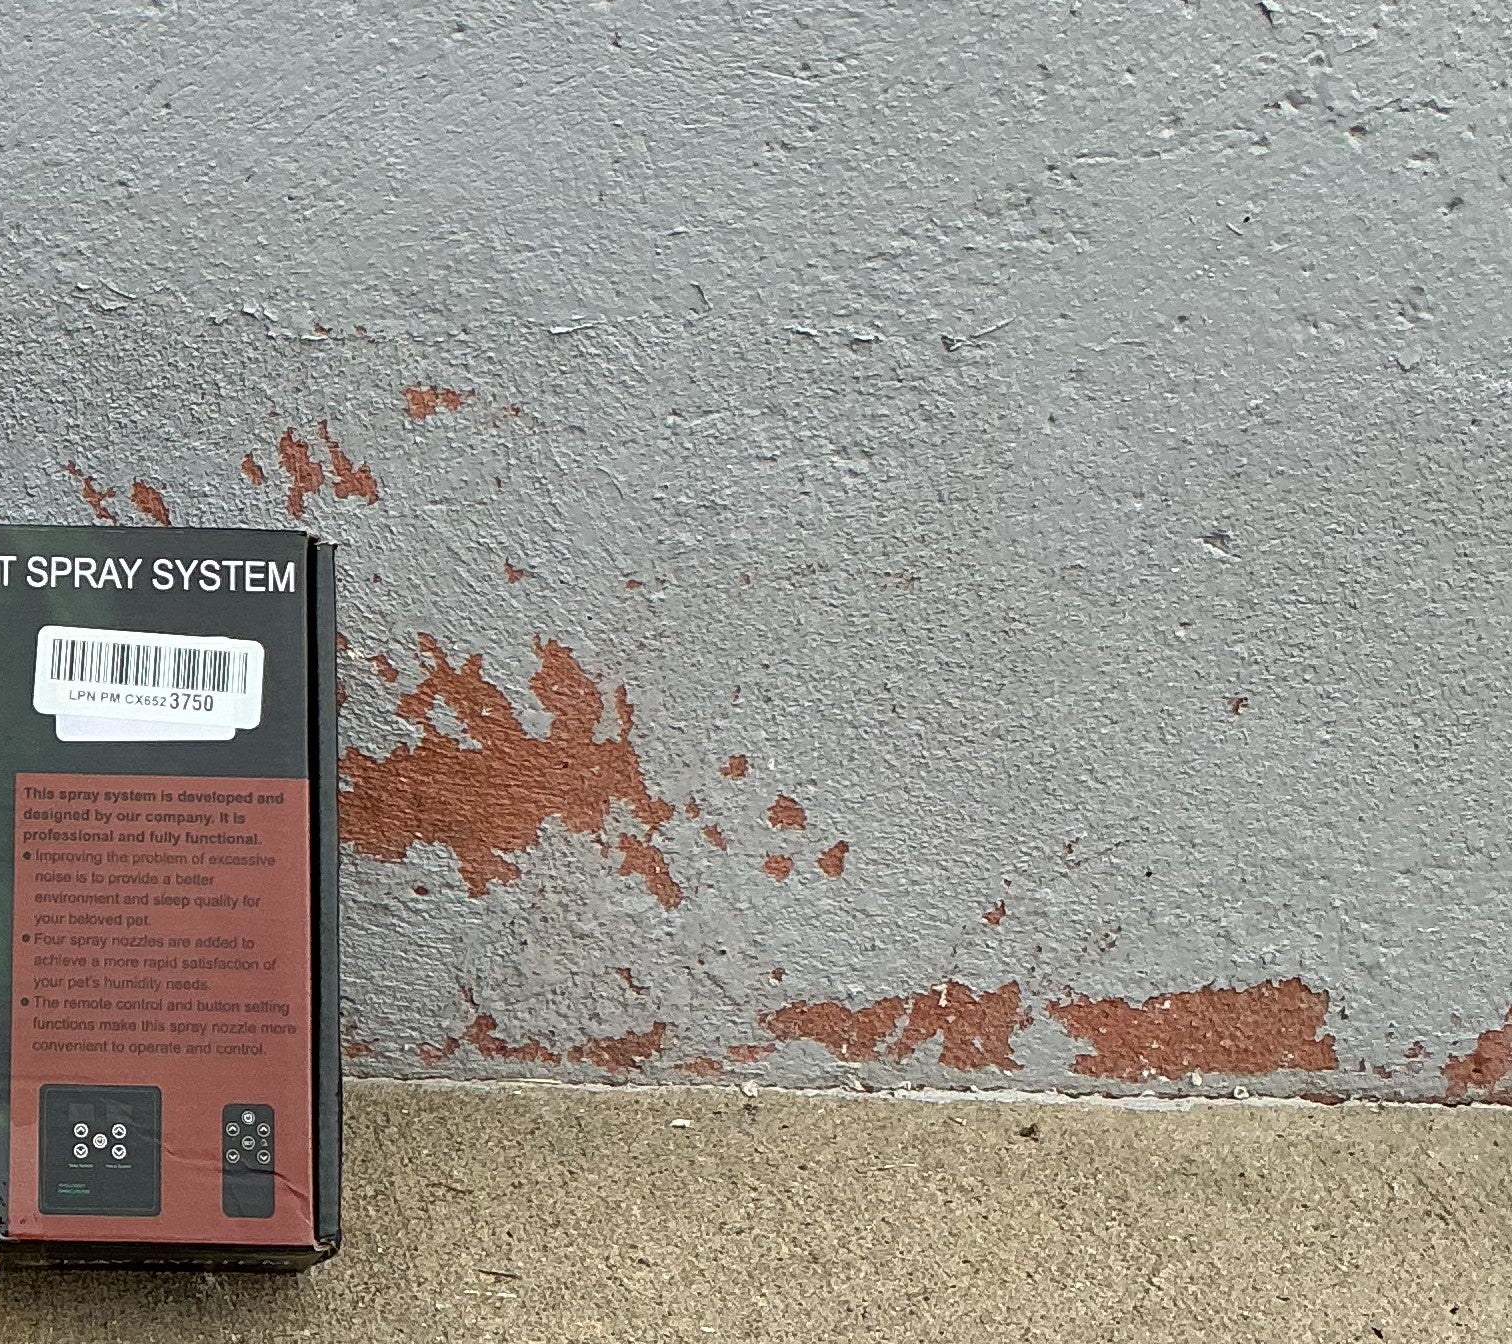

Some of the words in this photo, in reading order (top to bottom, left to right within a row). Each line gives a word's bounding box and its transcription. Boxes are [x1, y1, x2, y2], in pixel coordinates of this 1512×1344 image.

[26, 556, 142, 589] SPRAY
[152, 559, 296, 593] SYSTEM
[69, 690, 95, 702] LPN
[100, 692, 120, 703] PM
[24, 787, 55, 800] This
[59, 789, 99, 803] spray
[104, 790, 156, 804] system
[161, 790, 173, 803] is
[178, 791, 253, 806] developed
[257, 793, 284, 805] and
[23, 808, 90, 824] designed
[94, 809, 112, 824] by
[116, 814, 141, 822] our
[233, 812, 245, 824] is
[23, 829, 113, 844] professional
[118, 830, 145, 843] and
[150, 831, 180, 846] fully
[185, 832, 262, 845] functional.
[35, 849, 102, 865] Improving
[107, 851, 128, 863] the
[132, 851, 187, 866] problem
[192, 853, 205, 865] of
[209, 853, 276, 866] excessive
[35, 871, 71, 883] noise
[76, 872, 87, 884] is
[92, 872, 104, 884] to
[108, 873, 159, 885] provide
[163, 876, 171, 885] a
[175, 873, 214, 886] better
[34, 891, 119, 904] environment
[123, 892, 149, 905] and
[153, 892, 190, 909] sleep
[194, 893, 238, 910] quality
[242, 896, 261, 907] for
[34, 914, 64, 926] your
[68, 913, 122, 926] beloved
[34, 933, 66, 945] Four
[70, 935, 107, 949] spray
[111, 935, 164, 947] nozzles
[168, 938, 190, 948] are
[195, 936, 237, 949] added
[242, 937, 255, 949] to
[33, 954, 87, 967] achieve
[91, 957, 100, 967] a
[104, 957, 138, 968] more
[143, 956, 177, 971] rapid
[181, 958, 259, 970] satisfaction
[263, 958, 277, 970] of
[33, 977, 63, 989] your
[104, 977, 161, 992] humidity
[33, 996, 60, 1009] The
[63, 998, 112, 1009] remote
[115, 998, 163, 1011] control
[167, 999, 193, 1011] and
[197, 1000, 240, 1012] button
[244, 1001, 290, 1016] setting
[33, 1017, 95, 1031] functions
[99, 1020, 137, 1031] make
[141, 1018, 165, 1032] this
[170, 1022, 207, 1035] spray
[212, 1022, 257, 1034] nozzle
[261, 1024, 297, 1034] more
[32, 1041, 108, 1052] convenient
[111, 1041, 125, 1053] to
[128, 1042, 182, 1056] operate
[186, 1042, 211, 1054] and
